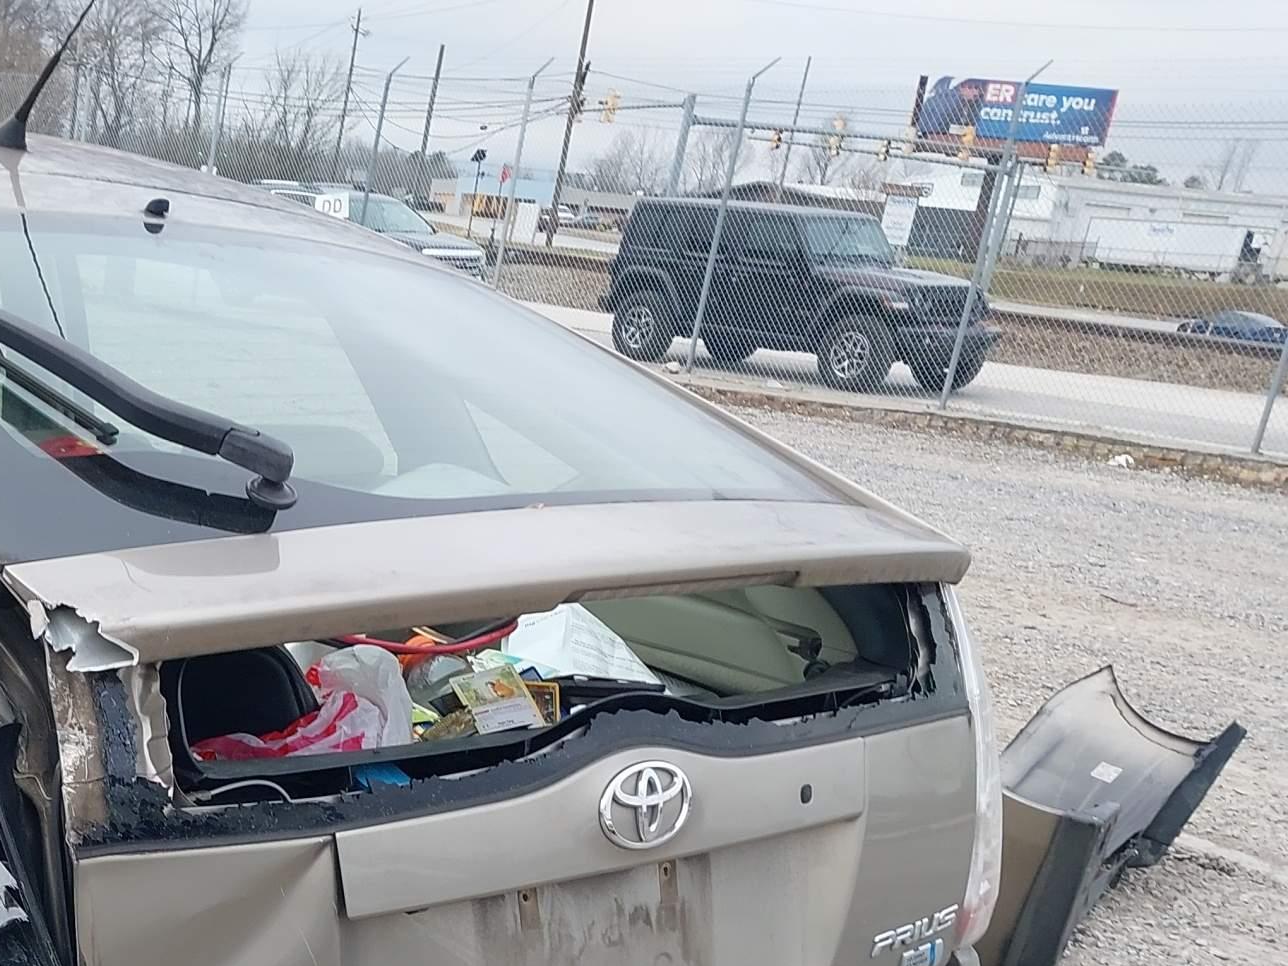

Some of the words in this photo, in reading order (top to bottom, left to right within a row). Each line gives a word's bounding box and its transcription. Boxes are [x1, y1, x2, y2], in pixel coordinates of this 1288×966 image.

[985, 83, 1015, 102] ER
[1060, 95, 1096, 112] you
[980, 106, 1013, 121] can
[871, 903, 959, 958] PRIUS
